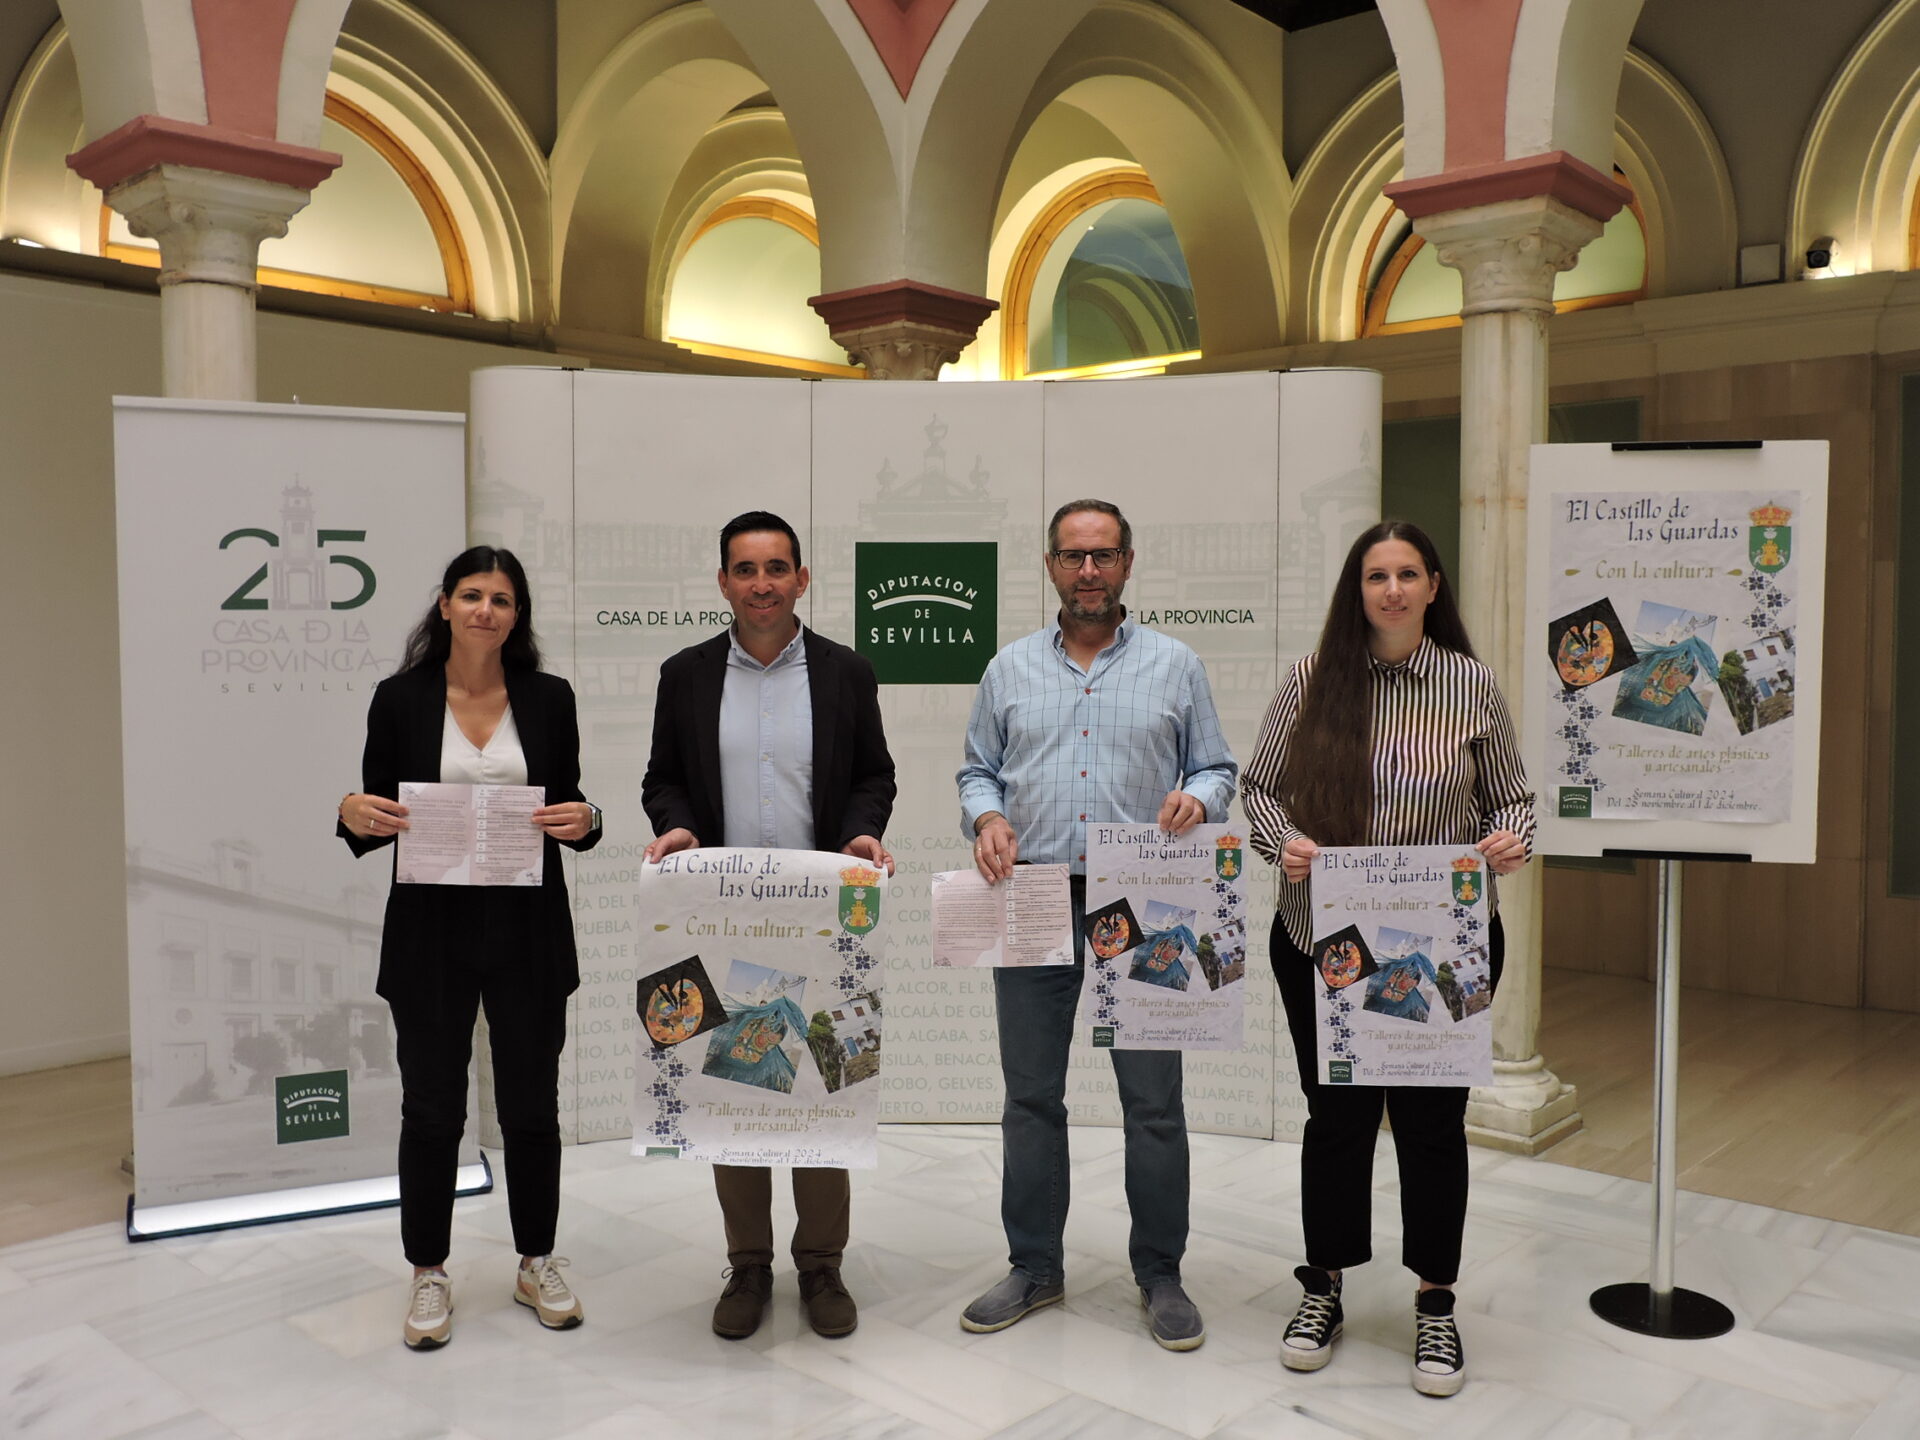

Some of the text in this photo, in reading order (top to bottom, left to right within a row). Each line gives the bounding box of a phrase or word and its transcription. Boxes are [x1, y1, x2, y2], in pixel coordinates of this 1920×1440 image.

[1568, 497, 1690, 522] El Castillo de
[1628, 518, 1738, 544] las Guardas
[218, 527, 377, 610] 25
[1596, 560, 1715, 579] Con la cultura
[867, 575, 978, 600] DIPUTACION
[597, 611, 642, 625] CASA
[648, 611, 668, 625] DE
[675, 611, 694, 625] LA
[915, 609, 930, 619] DE
[1140, 610, 1159, 624] LA
[1164, 609, 1255, 624] PROVINCIA
[212, 619, 290, 645] CASA
[342, 619, 371, 643] LA
[871, 627, 974, 644] SEVILLA
[1668, 745, 1682, 759] de
[1686, 748, 1715, 760] artes
[1719, 746, 1770, 764] plásticas
[1643, 764, 1653, 776] y
[1607, 797, 1621, 807] Del
[1641, 799, 1685, 809] noviembre
[1632, 788, 1734, 802] Semana Cultural 2024
[1098, 829, 1178, 845] El Castillo de
[1139, 844, 1209, 861] las Guardas
[657, 854, 781, 875] El Castillo de
[1323, 852, 1408, 870] El Castillo de
[1117, 871, 1194, 885] Con la cultura
[1366, 866, 1444, 886] las Guardas
[719, 876, 829, 902] las Guardas
[598, 894, 627, 909] DEL
[1345, 896, 1429, 911] Con la cultura
[686, 915, 804, 938] Con la cultura
[608, 944, 627, 958] DE
[896, 981, 952, 996] ALCOR,
[960, 982, 974, 994] EL
[945, 1005, 964, 1018] DE
[613, 1043, 632, 1057] LA
[884, 1030, 902, 1042] LA
[907, 1029, 973, 1044] ALGABA,
[1404, 1030, 1414, 1040] de
[283, 1087, 342, 1104] DIPUTACION
[938, 1077, 998, 1091] GELVES,
[1184, 1085, 1259, 1106] ALJARAFE,
[285, 1111, 341, 1126] SEVILLA
[757, 1104, 771, 1117] de
[775, 1107, 803, 1117] artes
[807, 1104, 856, 1121] plásticas
[1215, 1112, 1235, 1126] DE
[1245, 1114, 1263, 1128] LA
[732, 1122, 741, 1136] y
[757, 1148, 791, 1158] Cultural
[794, 1149, 821, 1158] 2024
